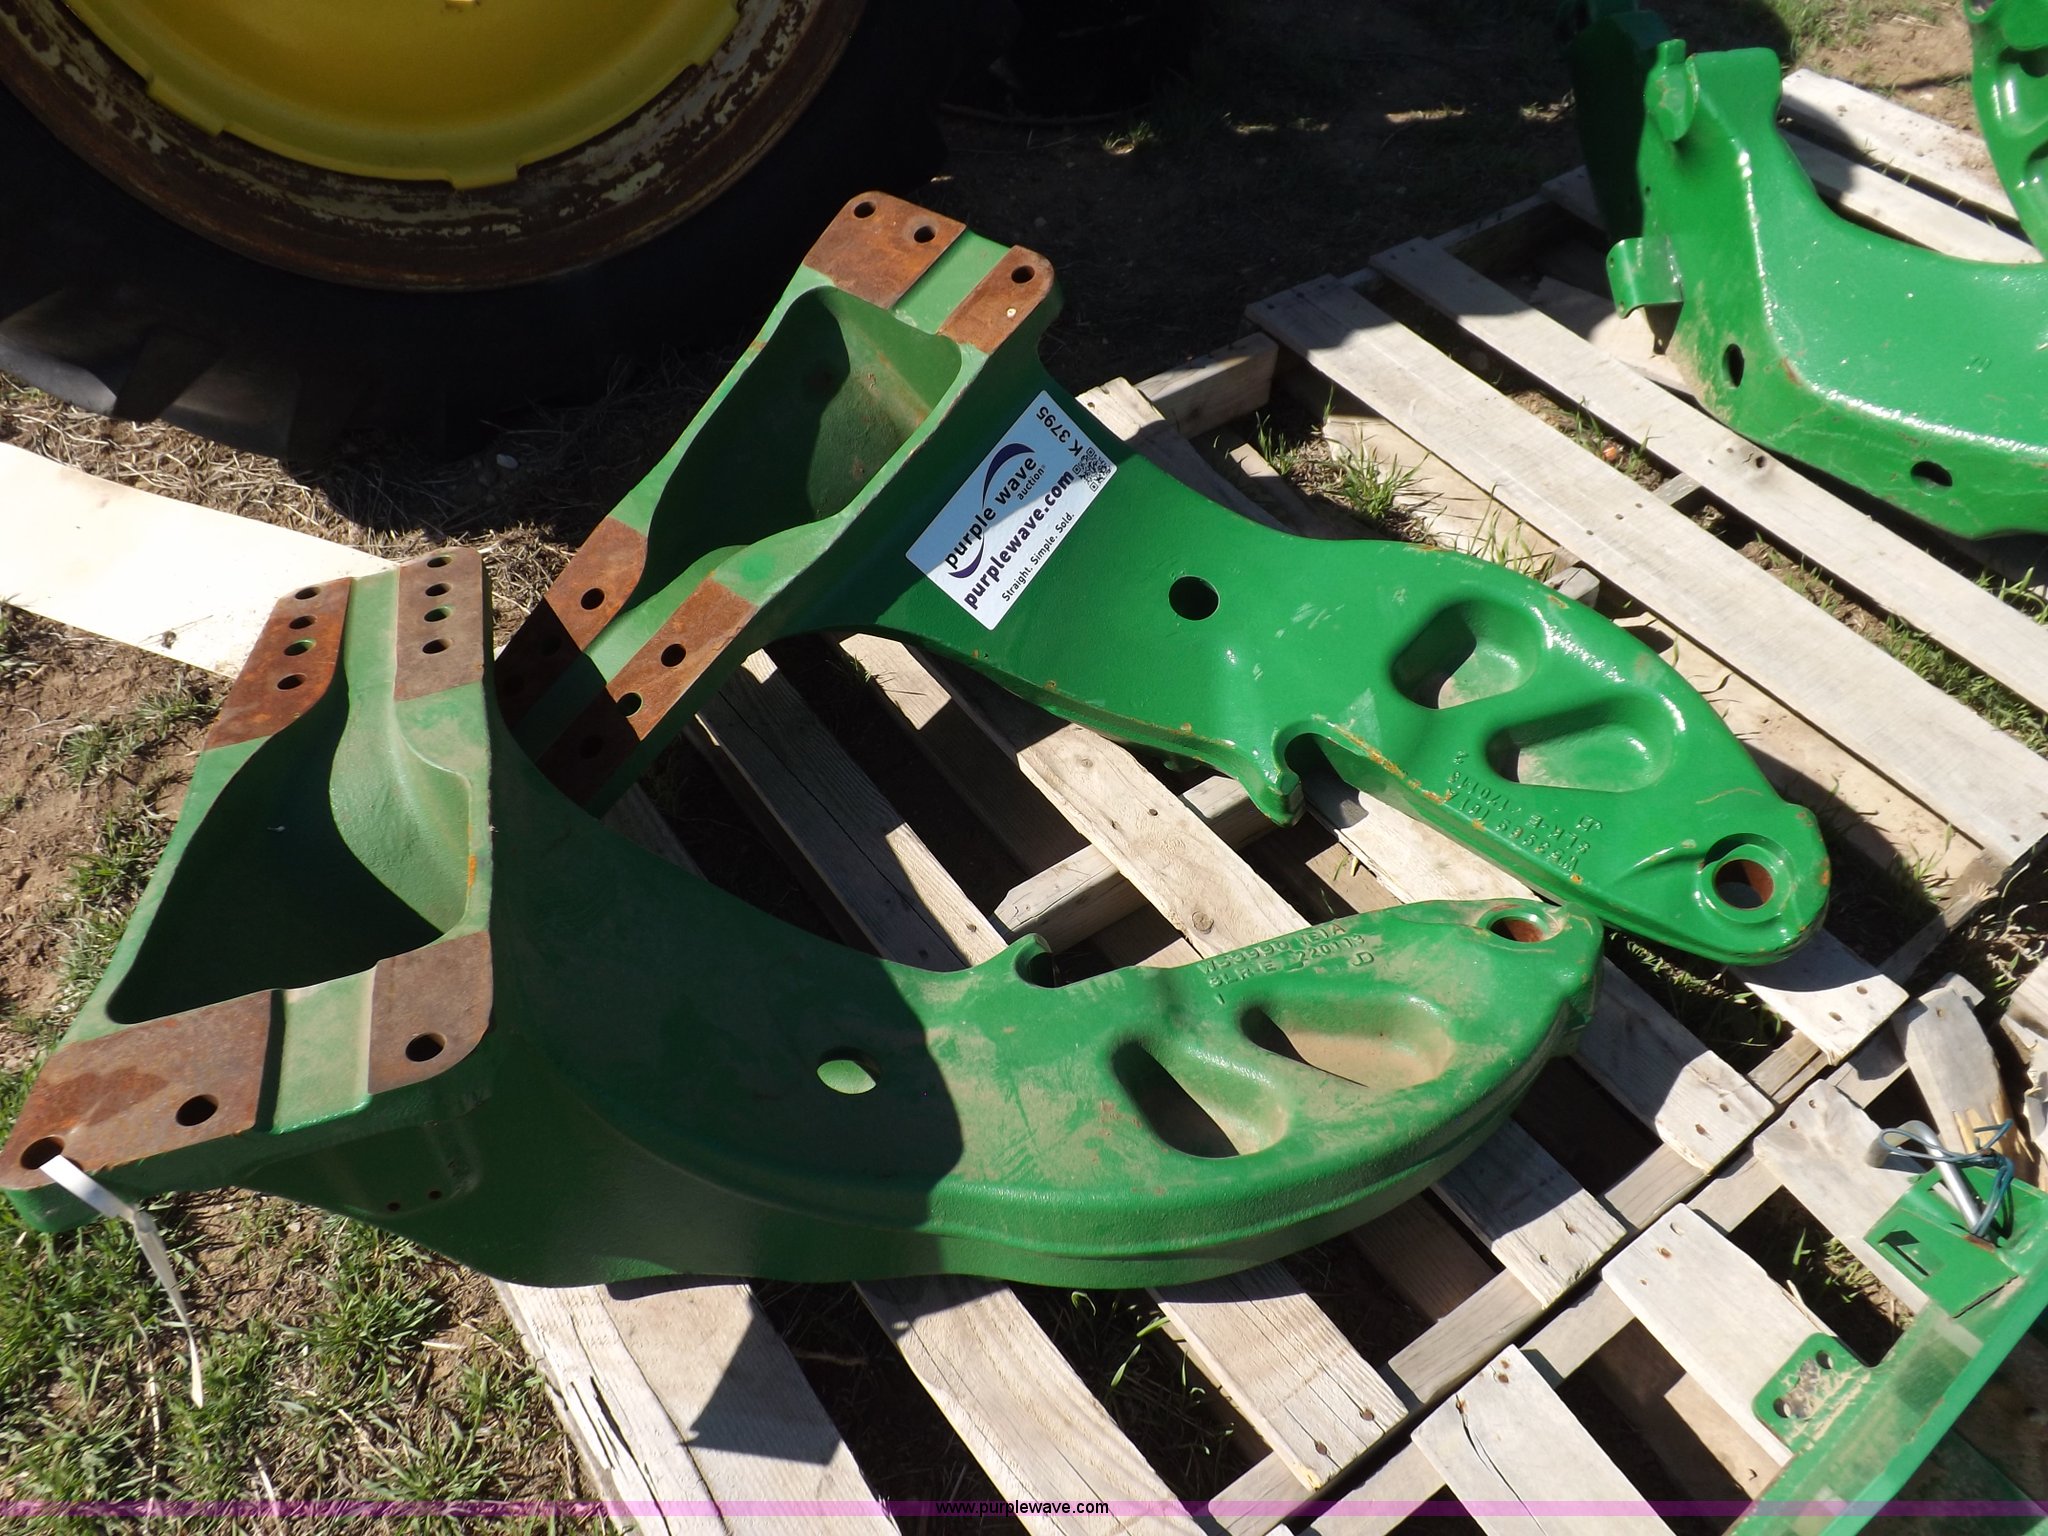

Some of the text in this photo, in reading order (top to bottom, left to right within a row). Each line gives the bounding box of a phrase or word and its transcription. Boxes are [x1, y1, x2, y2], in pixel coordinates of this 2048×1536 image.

[1036, 406, 1084, 457] K 3795
[944, 454, 1038, 570] purple wave
[963, 469, 1075, 611] purplewave.com
[1001, 512, 1076, 602] Straight. Simple. Sold.
